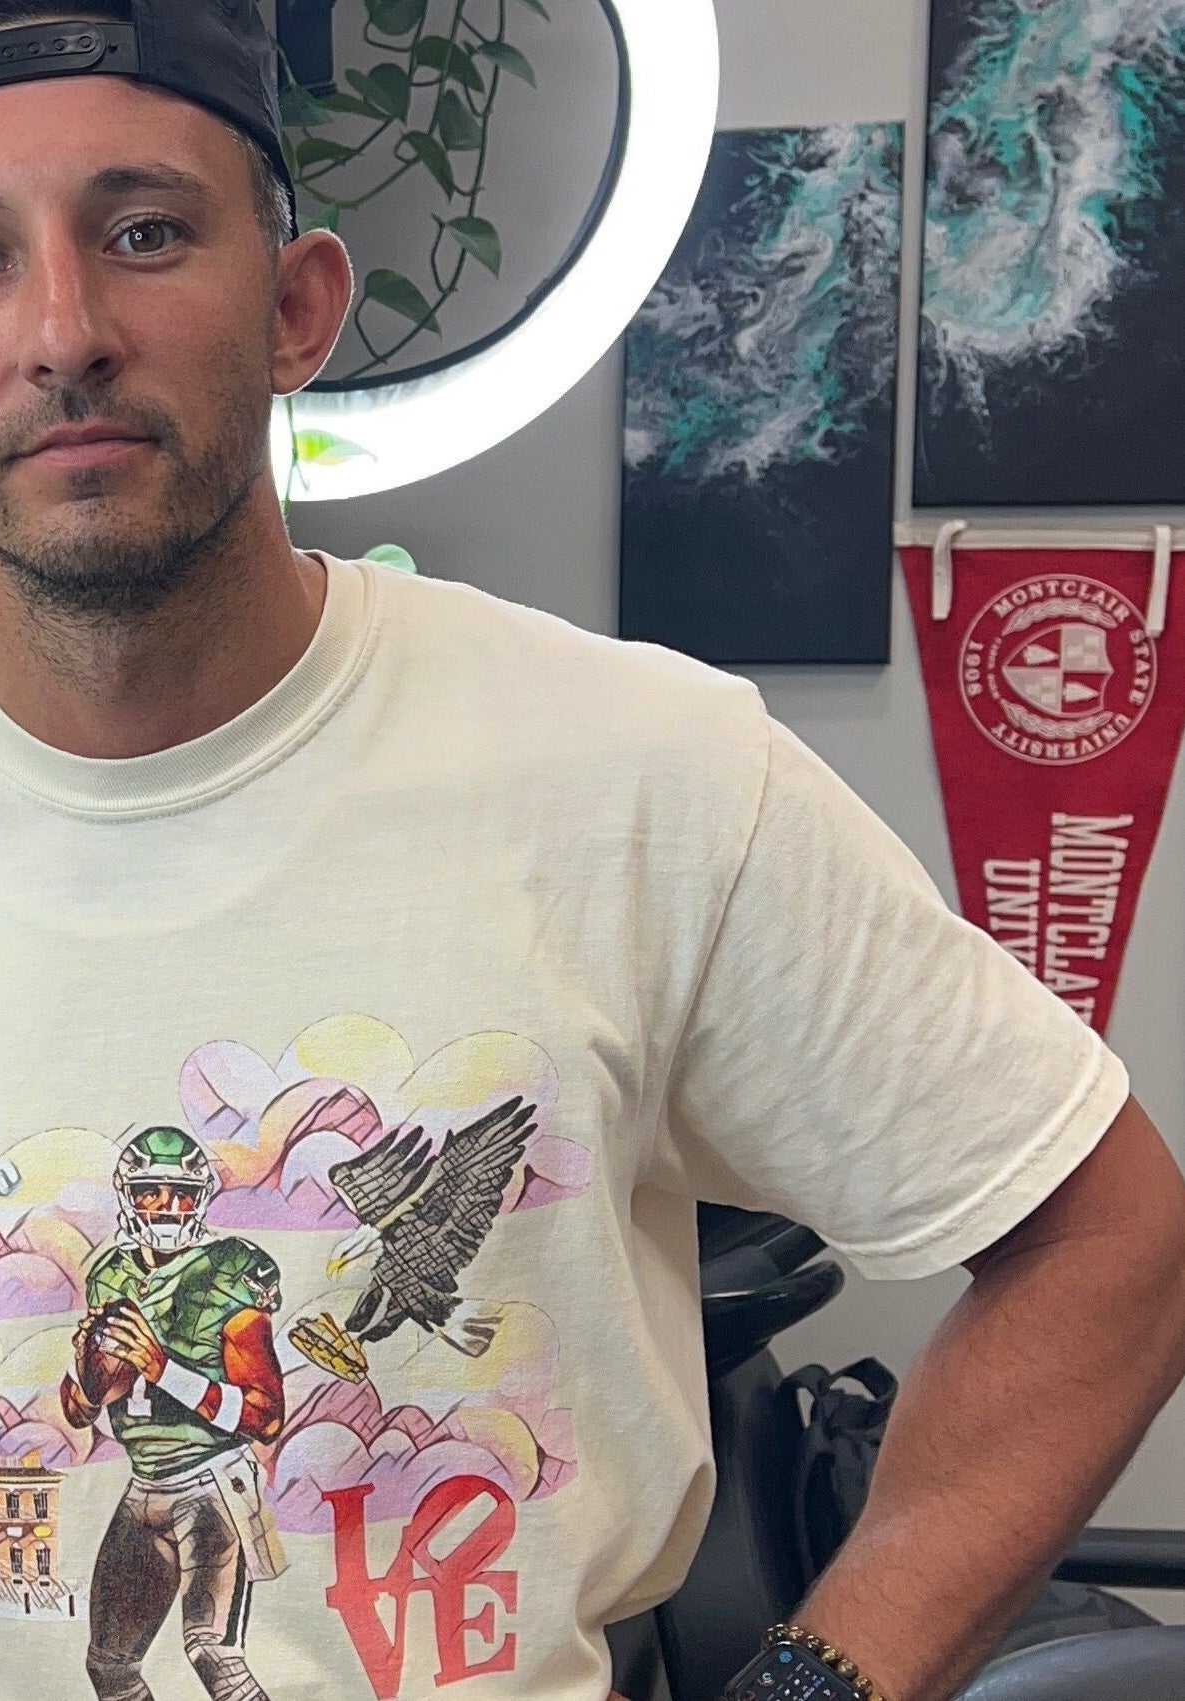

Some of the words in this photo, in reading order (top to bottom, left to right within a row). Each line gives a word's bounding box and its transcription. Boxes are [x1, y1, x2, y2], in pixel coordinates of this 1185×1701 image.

[991, 580, 1131, 624] MONTCLAIR
[1128, 628, 1152, 706] STATE
[990, 712, 1132, 760] UNIVERSITY
[1043, 812, 1135, 1027] MONTCLA
